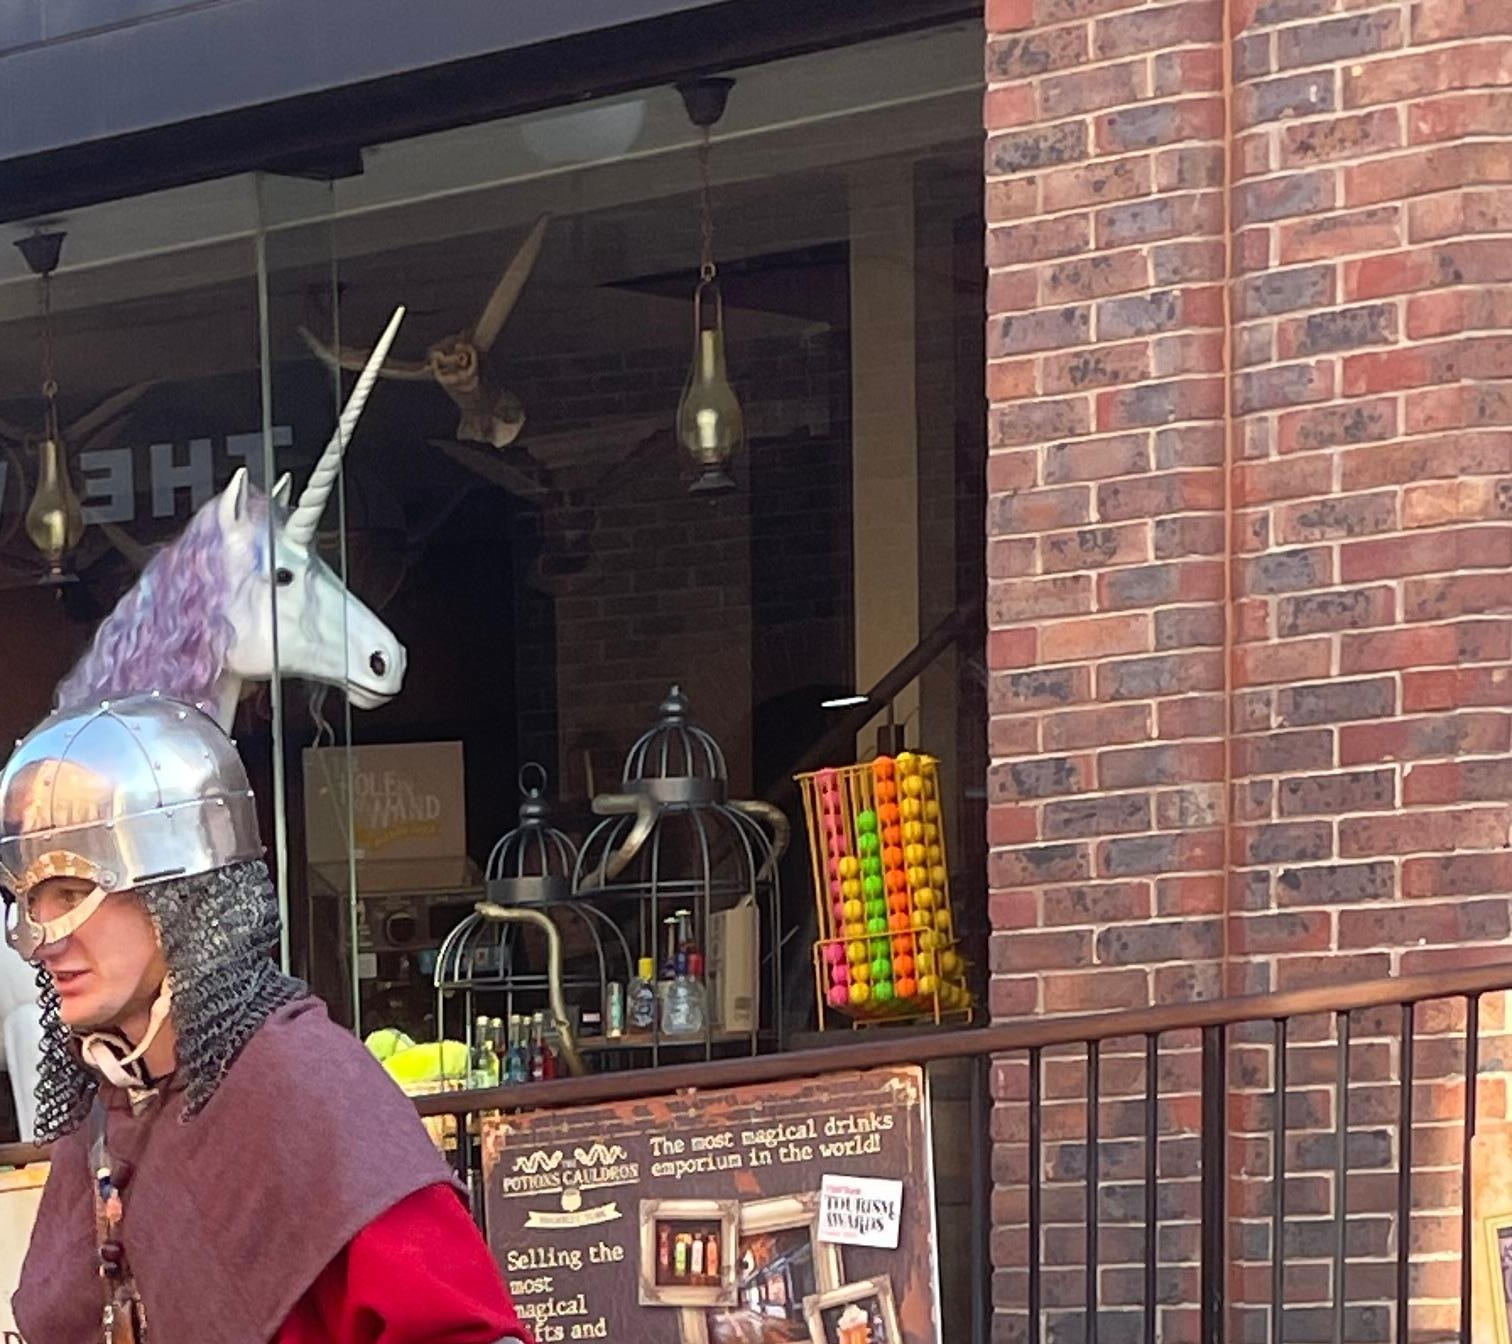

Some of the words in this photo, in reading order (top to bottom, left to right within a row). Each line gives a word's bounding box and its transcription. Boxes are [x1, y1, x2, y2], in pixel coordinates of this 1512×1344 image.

[649, 1136, 685, 1158] The
[691, 1131, 736, 1153] most
[741, 1118, 818, 1148] magical
[823, 1112, 895, 1137] drinks
[651, 1153, 743, 1179] emporium
[748, 1147, 773, 1168] in
[778, 1143, 813, 1164] the
[819, 1134, 881, 1158] world!
[507, 1246, 583, 1272] Selling
[589, 1241, 625, 1264] the
[509, 1275, 555, 1296] most
[534, 1322, 565, 1343] fts
[570, 1317, 608, 1341] and
